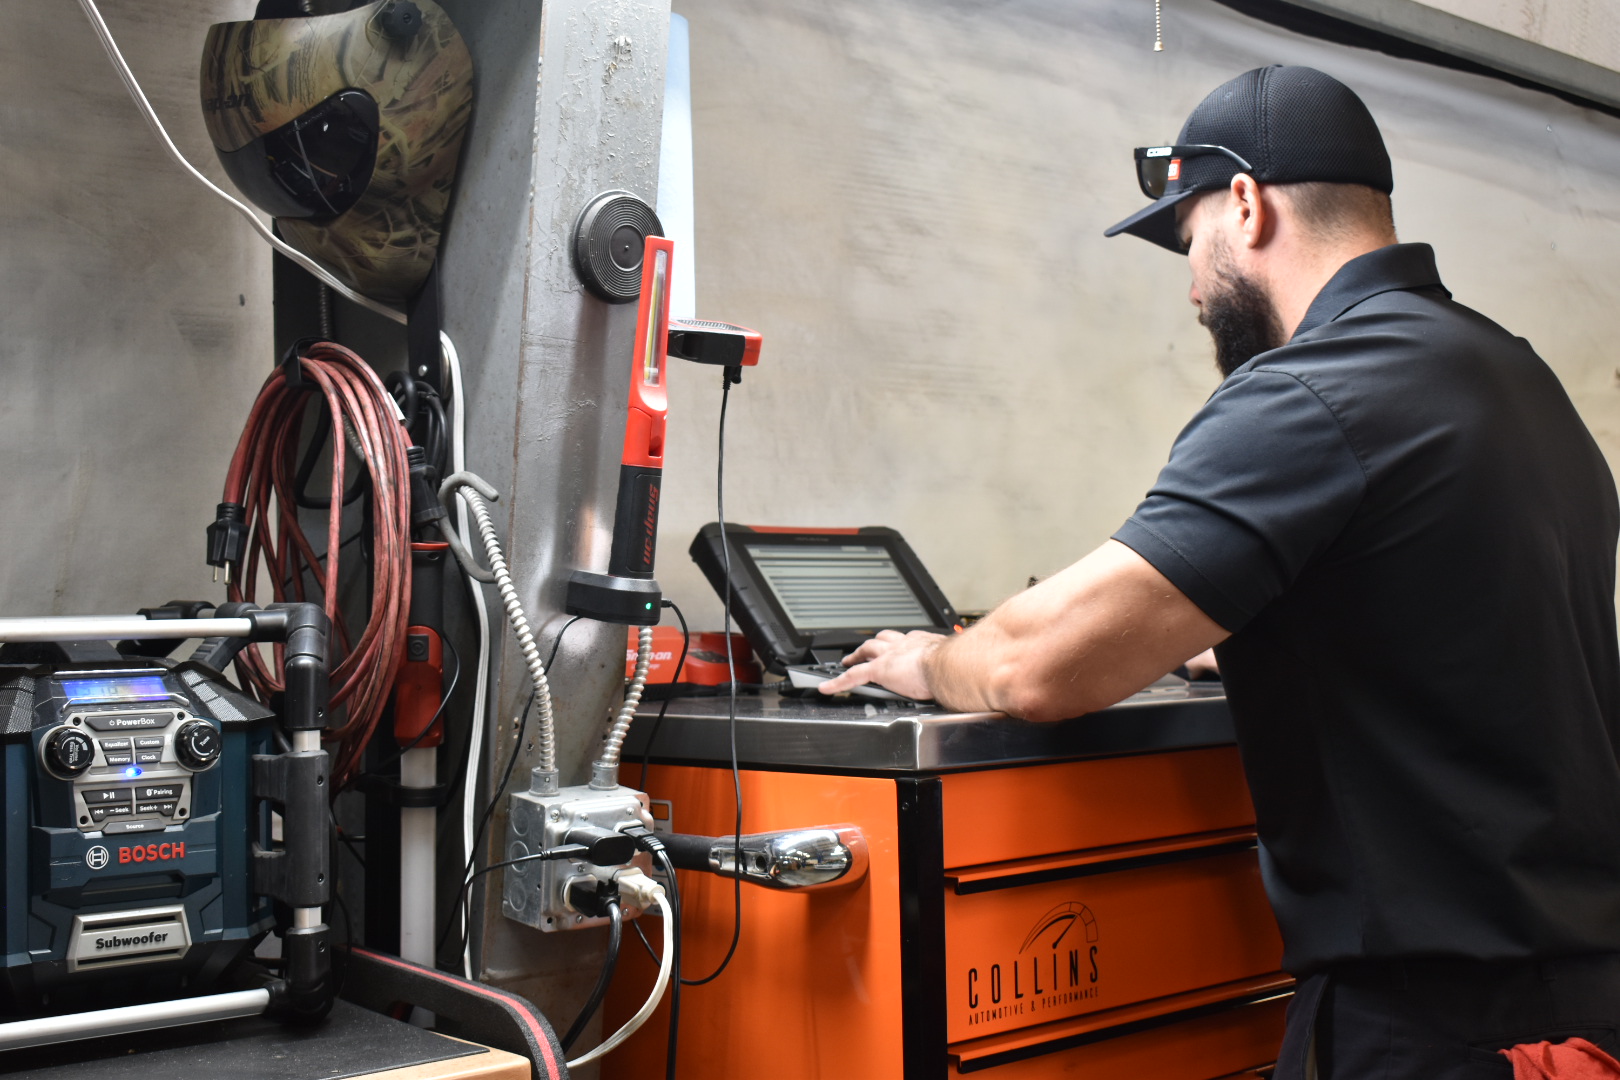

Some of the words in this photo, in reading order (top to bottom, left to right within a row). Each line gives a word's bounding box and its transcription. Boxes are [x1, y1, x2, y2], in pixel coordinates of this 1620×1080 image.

[116, 718, 155, 726] PowerBox
[199, 736, 211, 747] Tune
[153, 788, 173, 796] Pairing
[118, 842, 185, 864] BOSCH
[95, 931, 169, 950] Subwoofer
[968, 1003, 1024, 1026] AUTOMOTIVE
[1030, 1000, 1036, 1012] &
[1042, 986, 1099, 1009] PERFORMANCE
